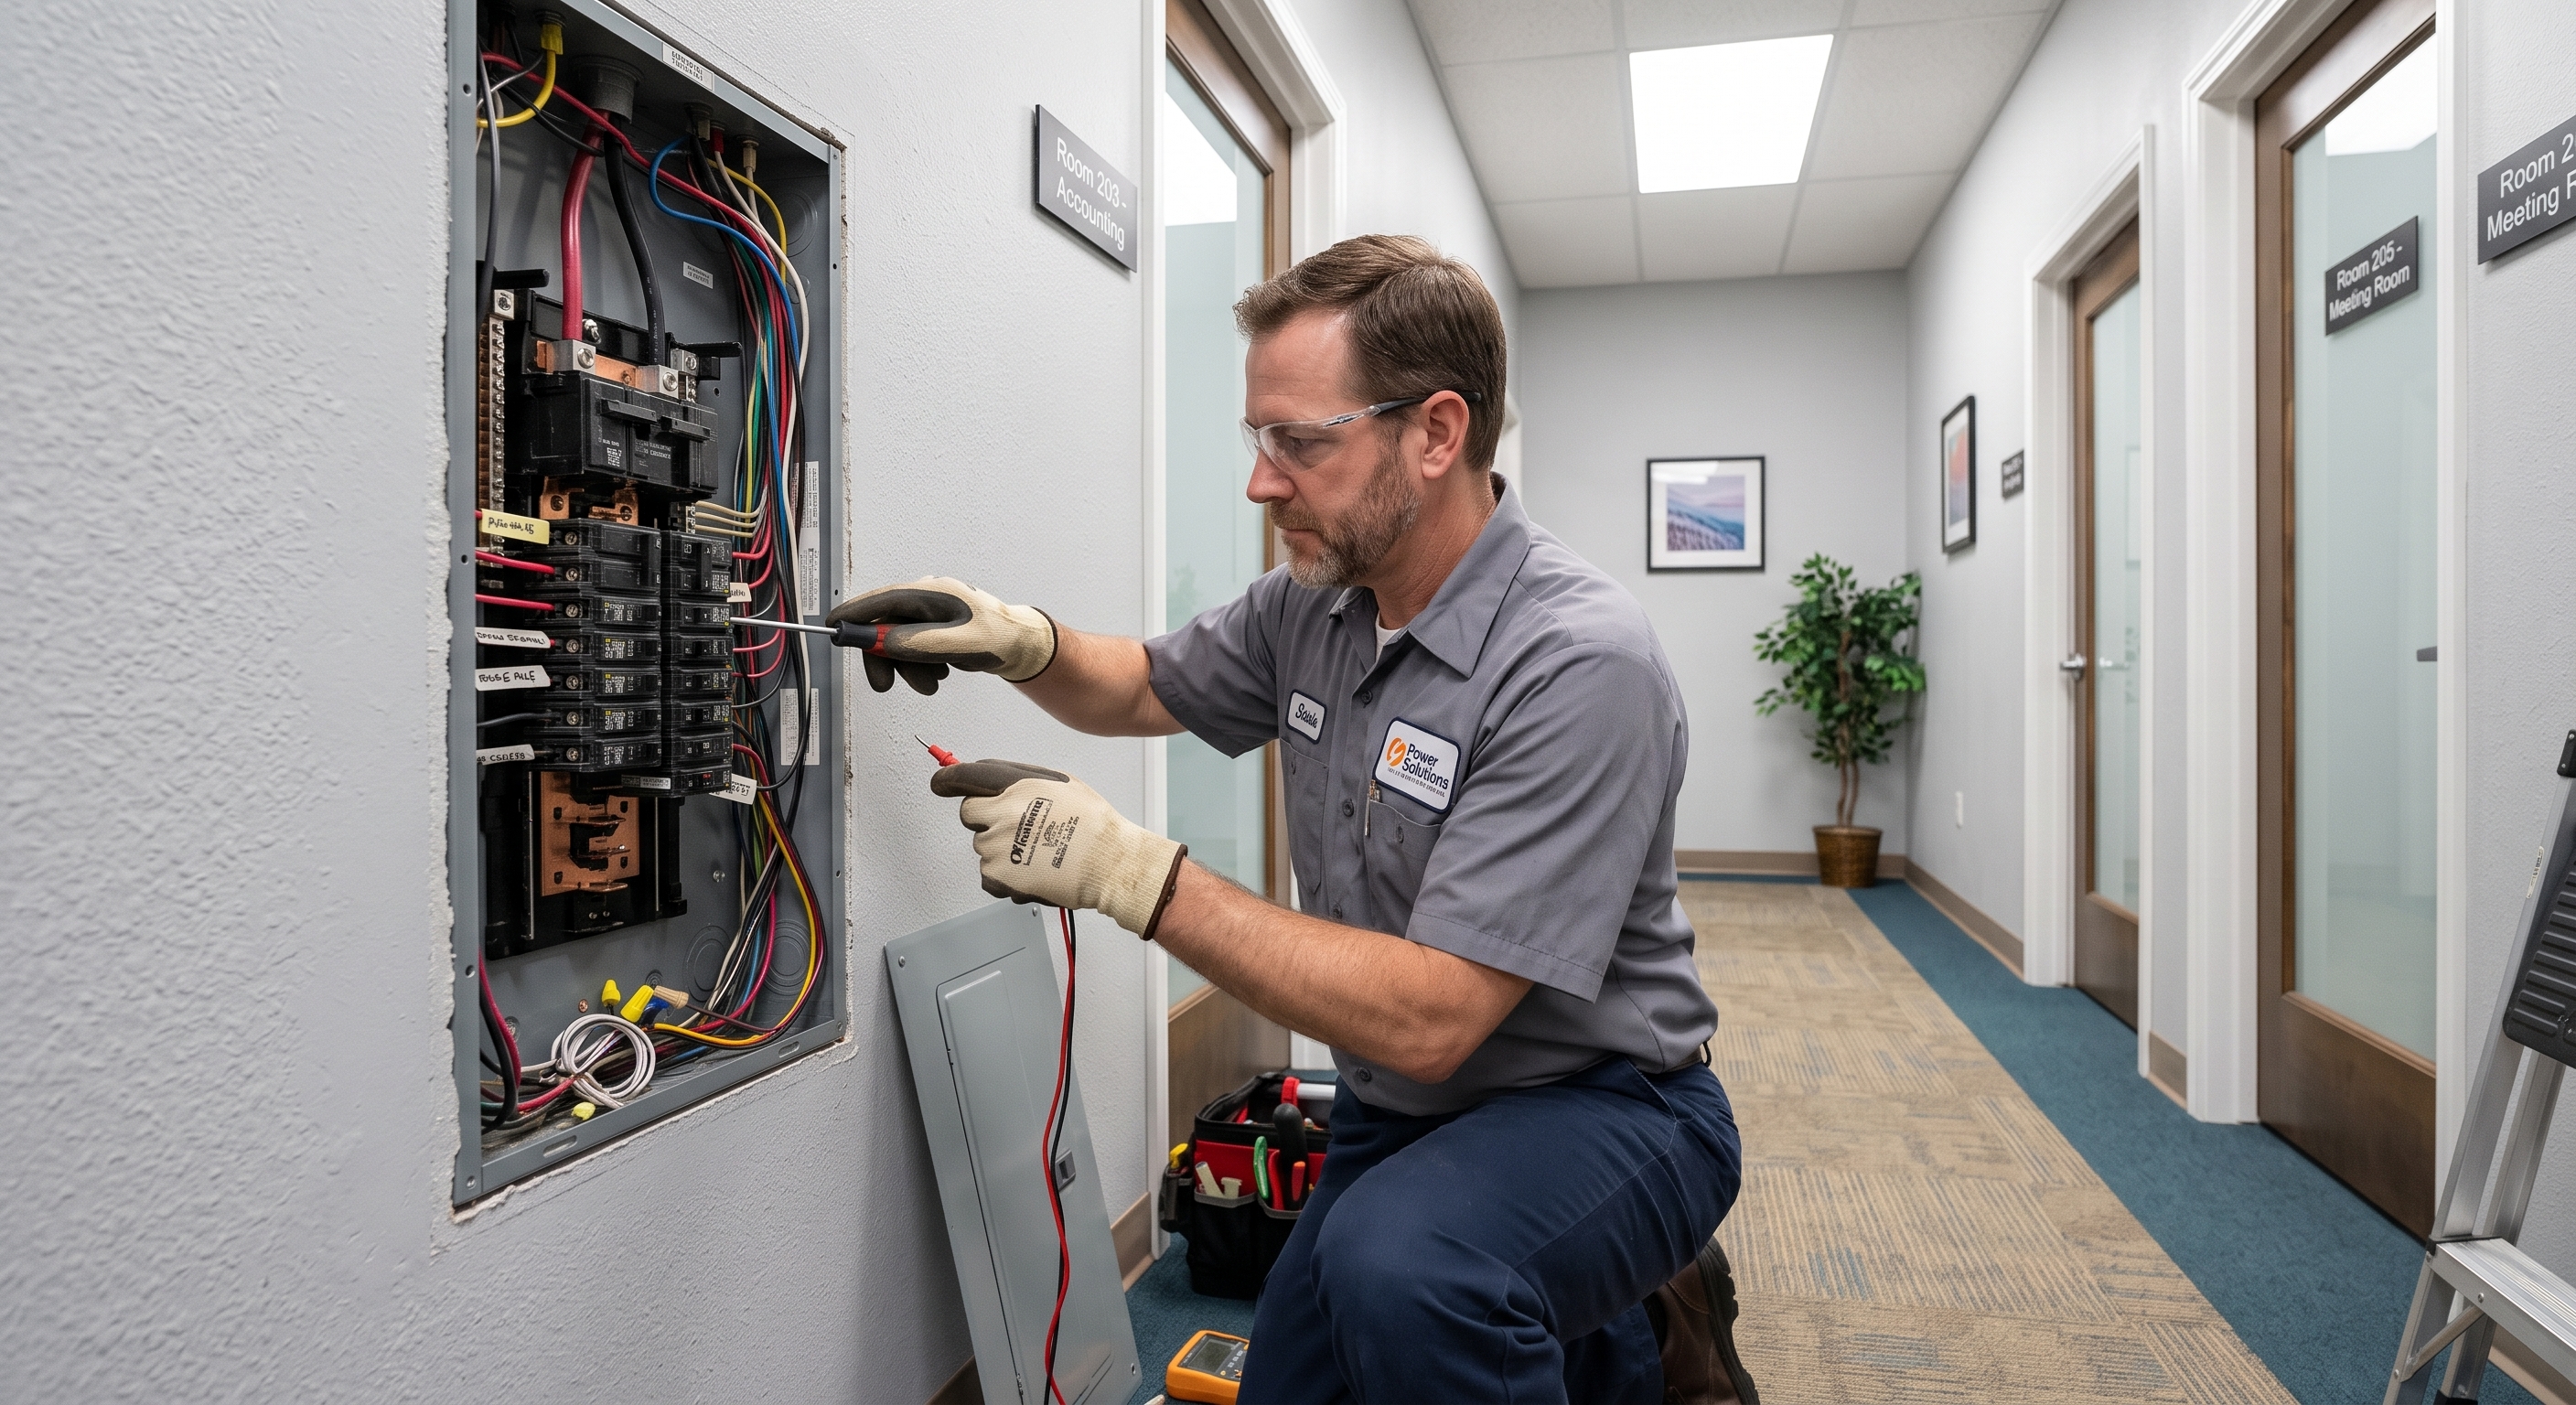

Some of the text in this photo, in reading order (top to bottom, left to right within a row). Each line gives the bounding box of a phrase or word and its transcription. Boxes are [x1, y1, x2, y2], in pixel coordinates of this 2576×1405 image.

[1057, 136, 1094, 188] Room
[1097, 171, 1120, 208] 203
[2500, 150, 2555, 198] Room
[1057, 176, 1125, 252] Accounting
[2487, 186, 2560, 241] Meeting
[2336, 260, 2369, 291] Room
[2372, 240, 2395, 272] 205
[2329, 264, 2410, 322] Meeting Room
[1401, 757, 1449, 790] Solutions
[1406, 743, 1439, 767] Power
